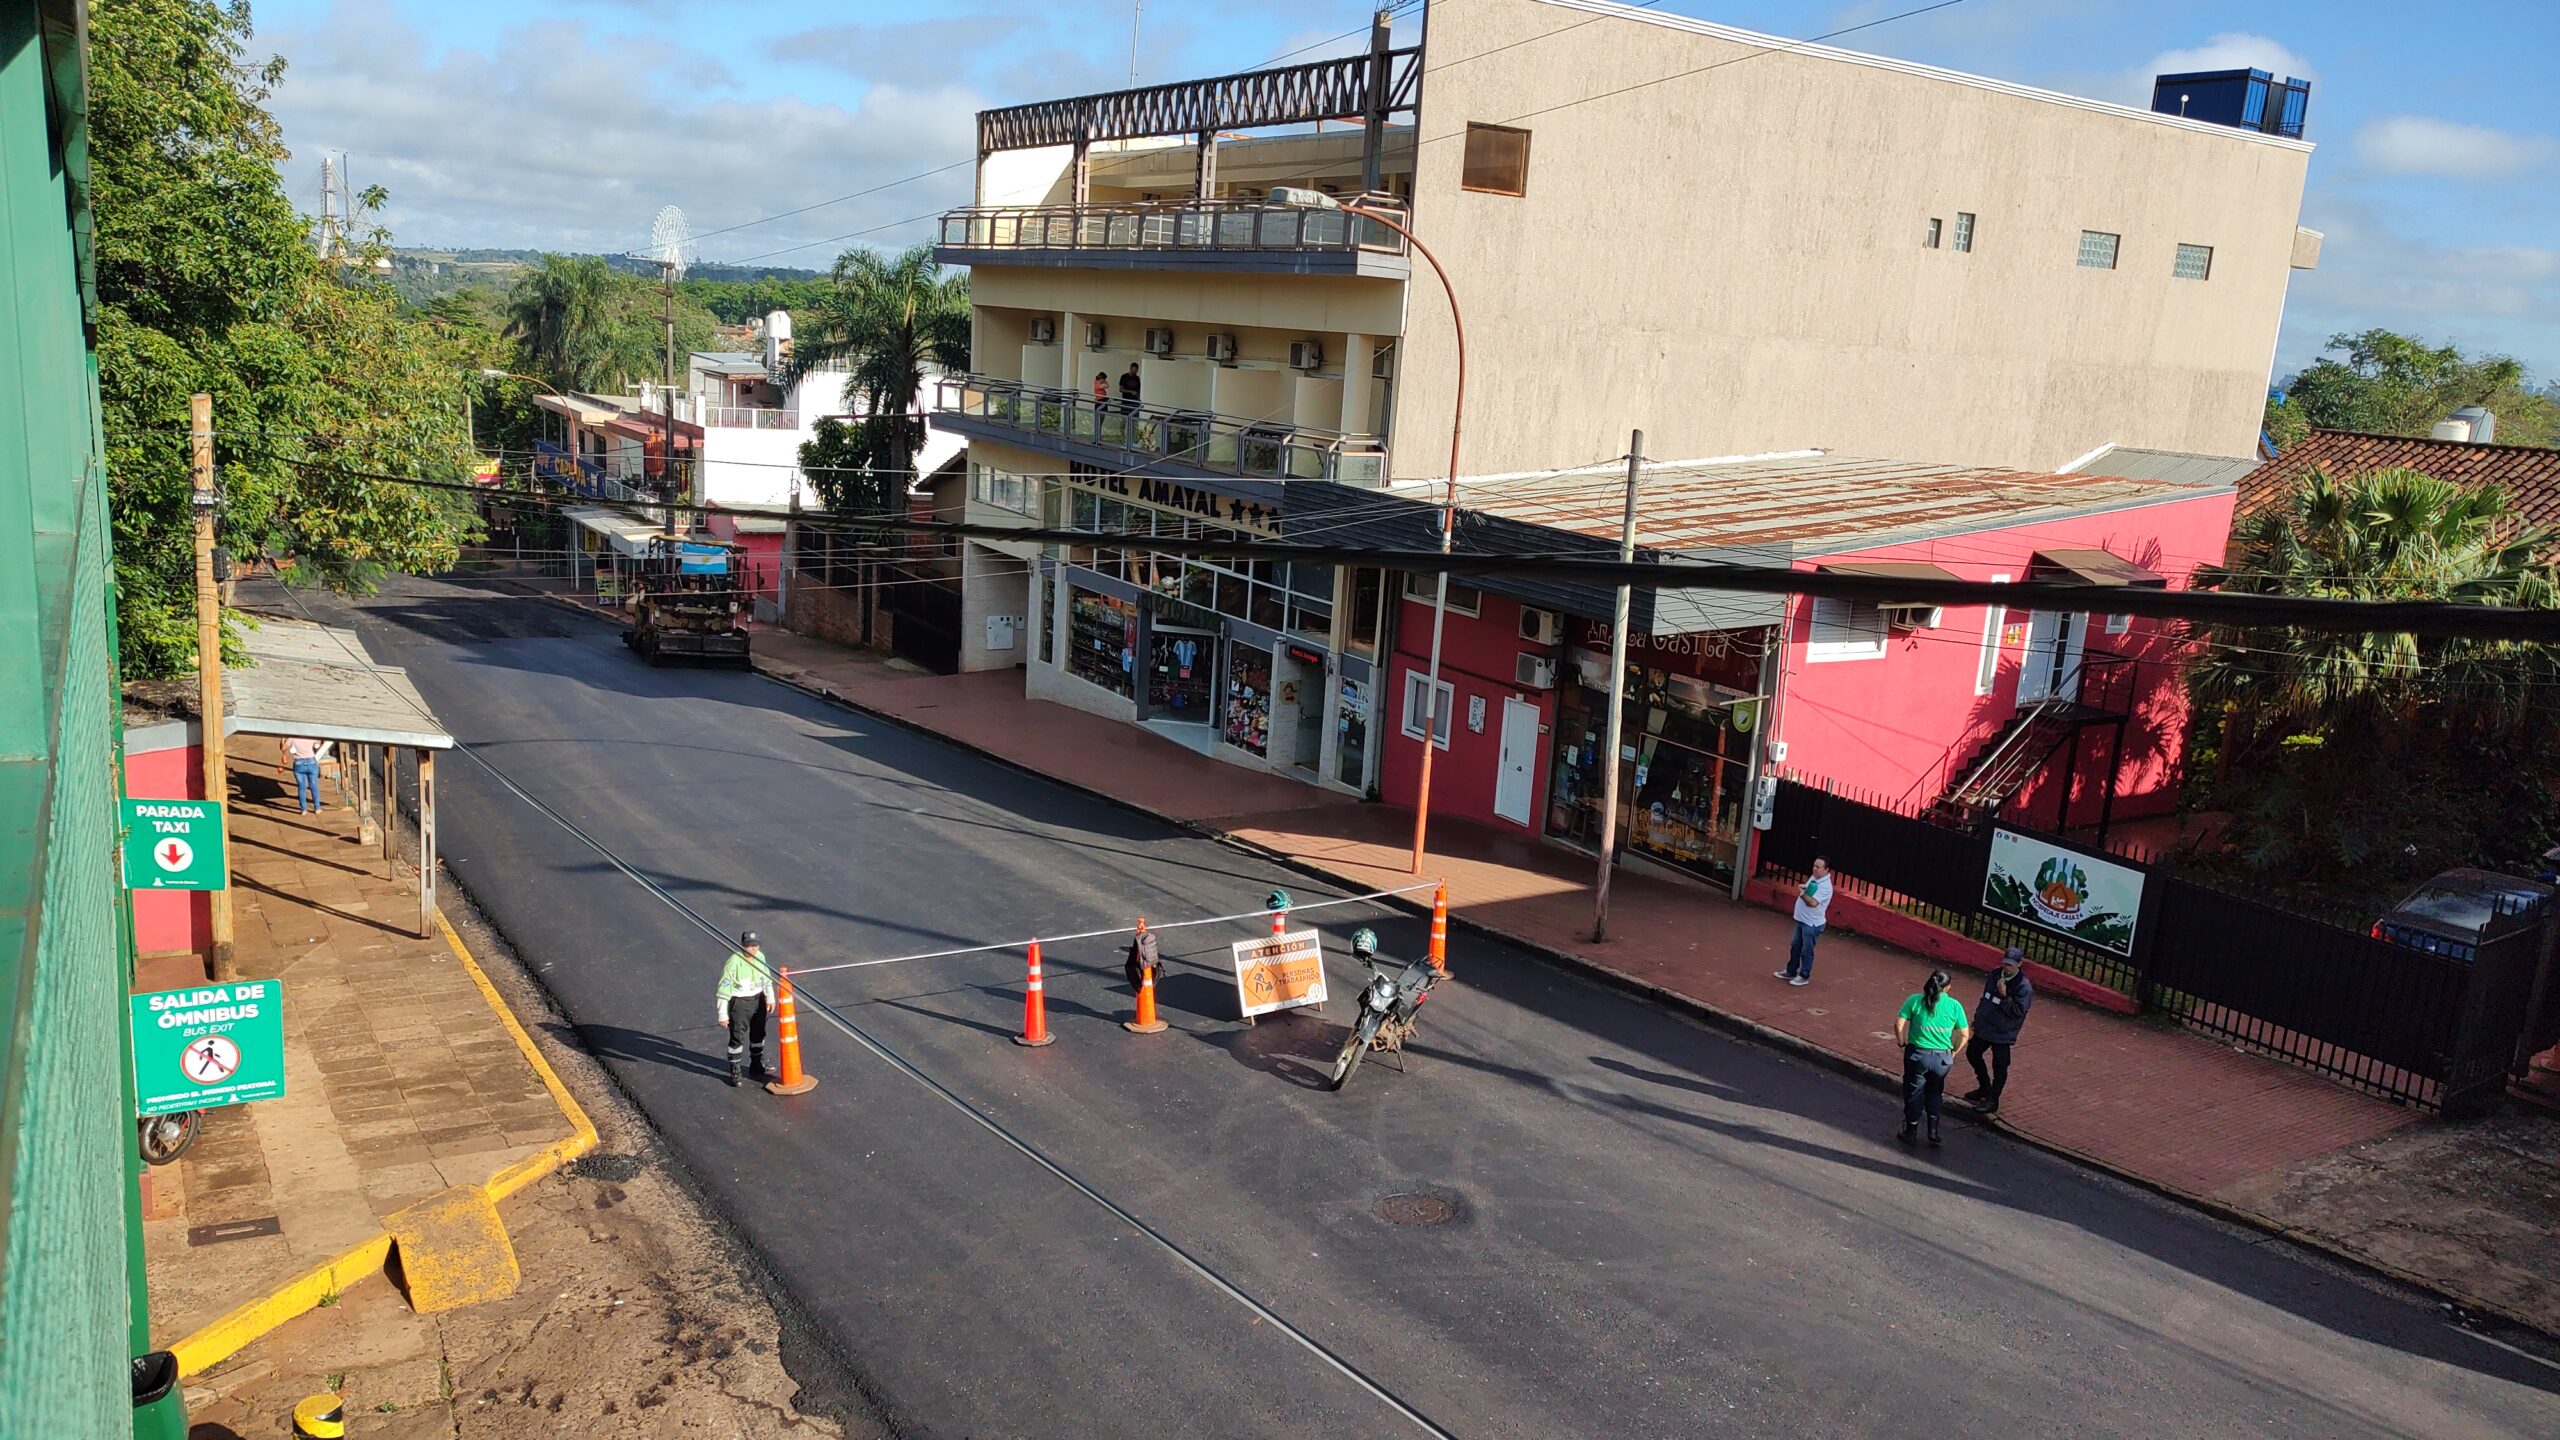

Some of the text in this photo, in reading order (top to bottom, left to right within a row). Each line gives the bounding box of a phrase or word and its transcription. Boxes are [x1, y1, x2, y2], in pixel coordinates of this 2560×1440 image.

[1070, 461, 1221, 517] HOTEL AMAYAL
[136, 805, 205, 818] PARADA
[152, 820, 190, 833] TAXI
[1251, 941, 1305, 958] ATENCIÓN
[1282, 967, 1315, 978] PERSONAS
[149, 984, 265, 1011] SALIDA DE
[158, 1004, 259, 1028] ÓMNIBUS
[183, 1022, 234, 1037] BUS EXIT
